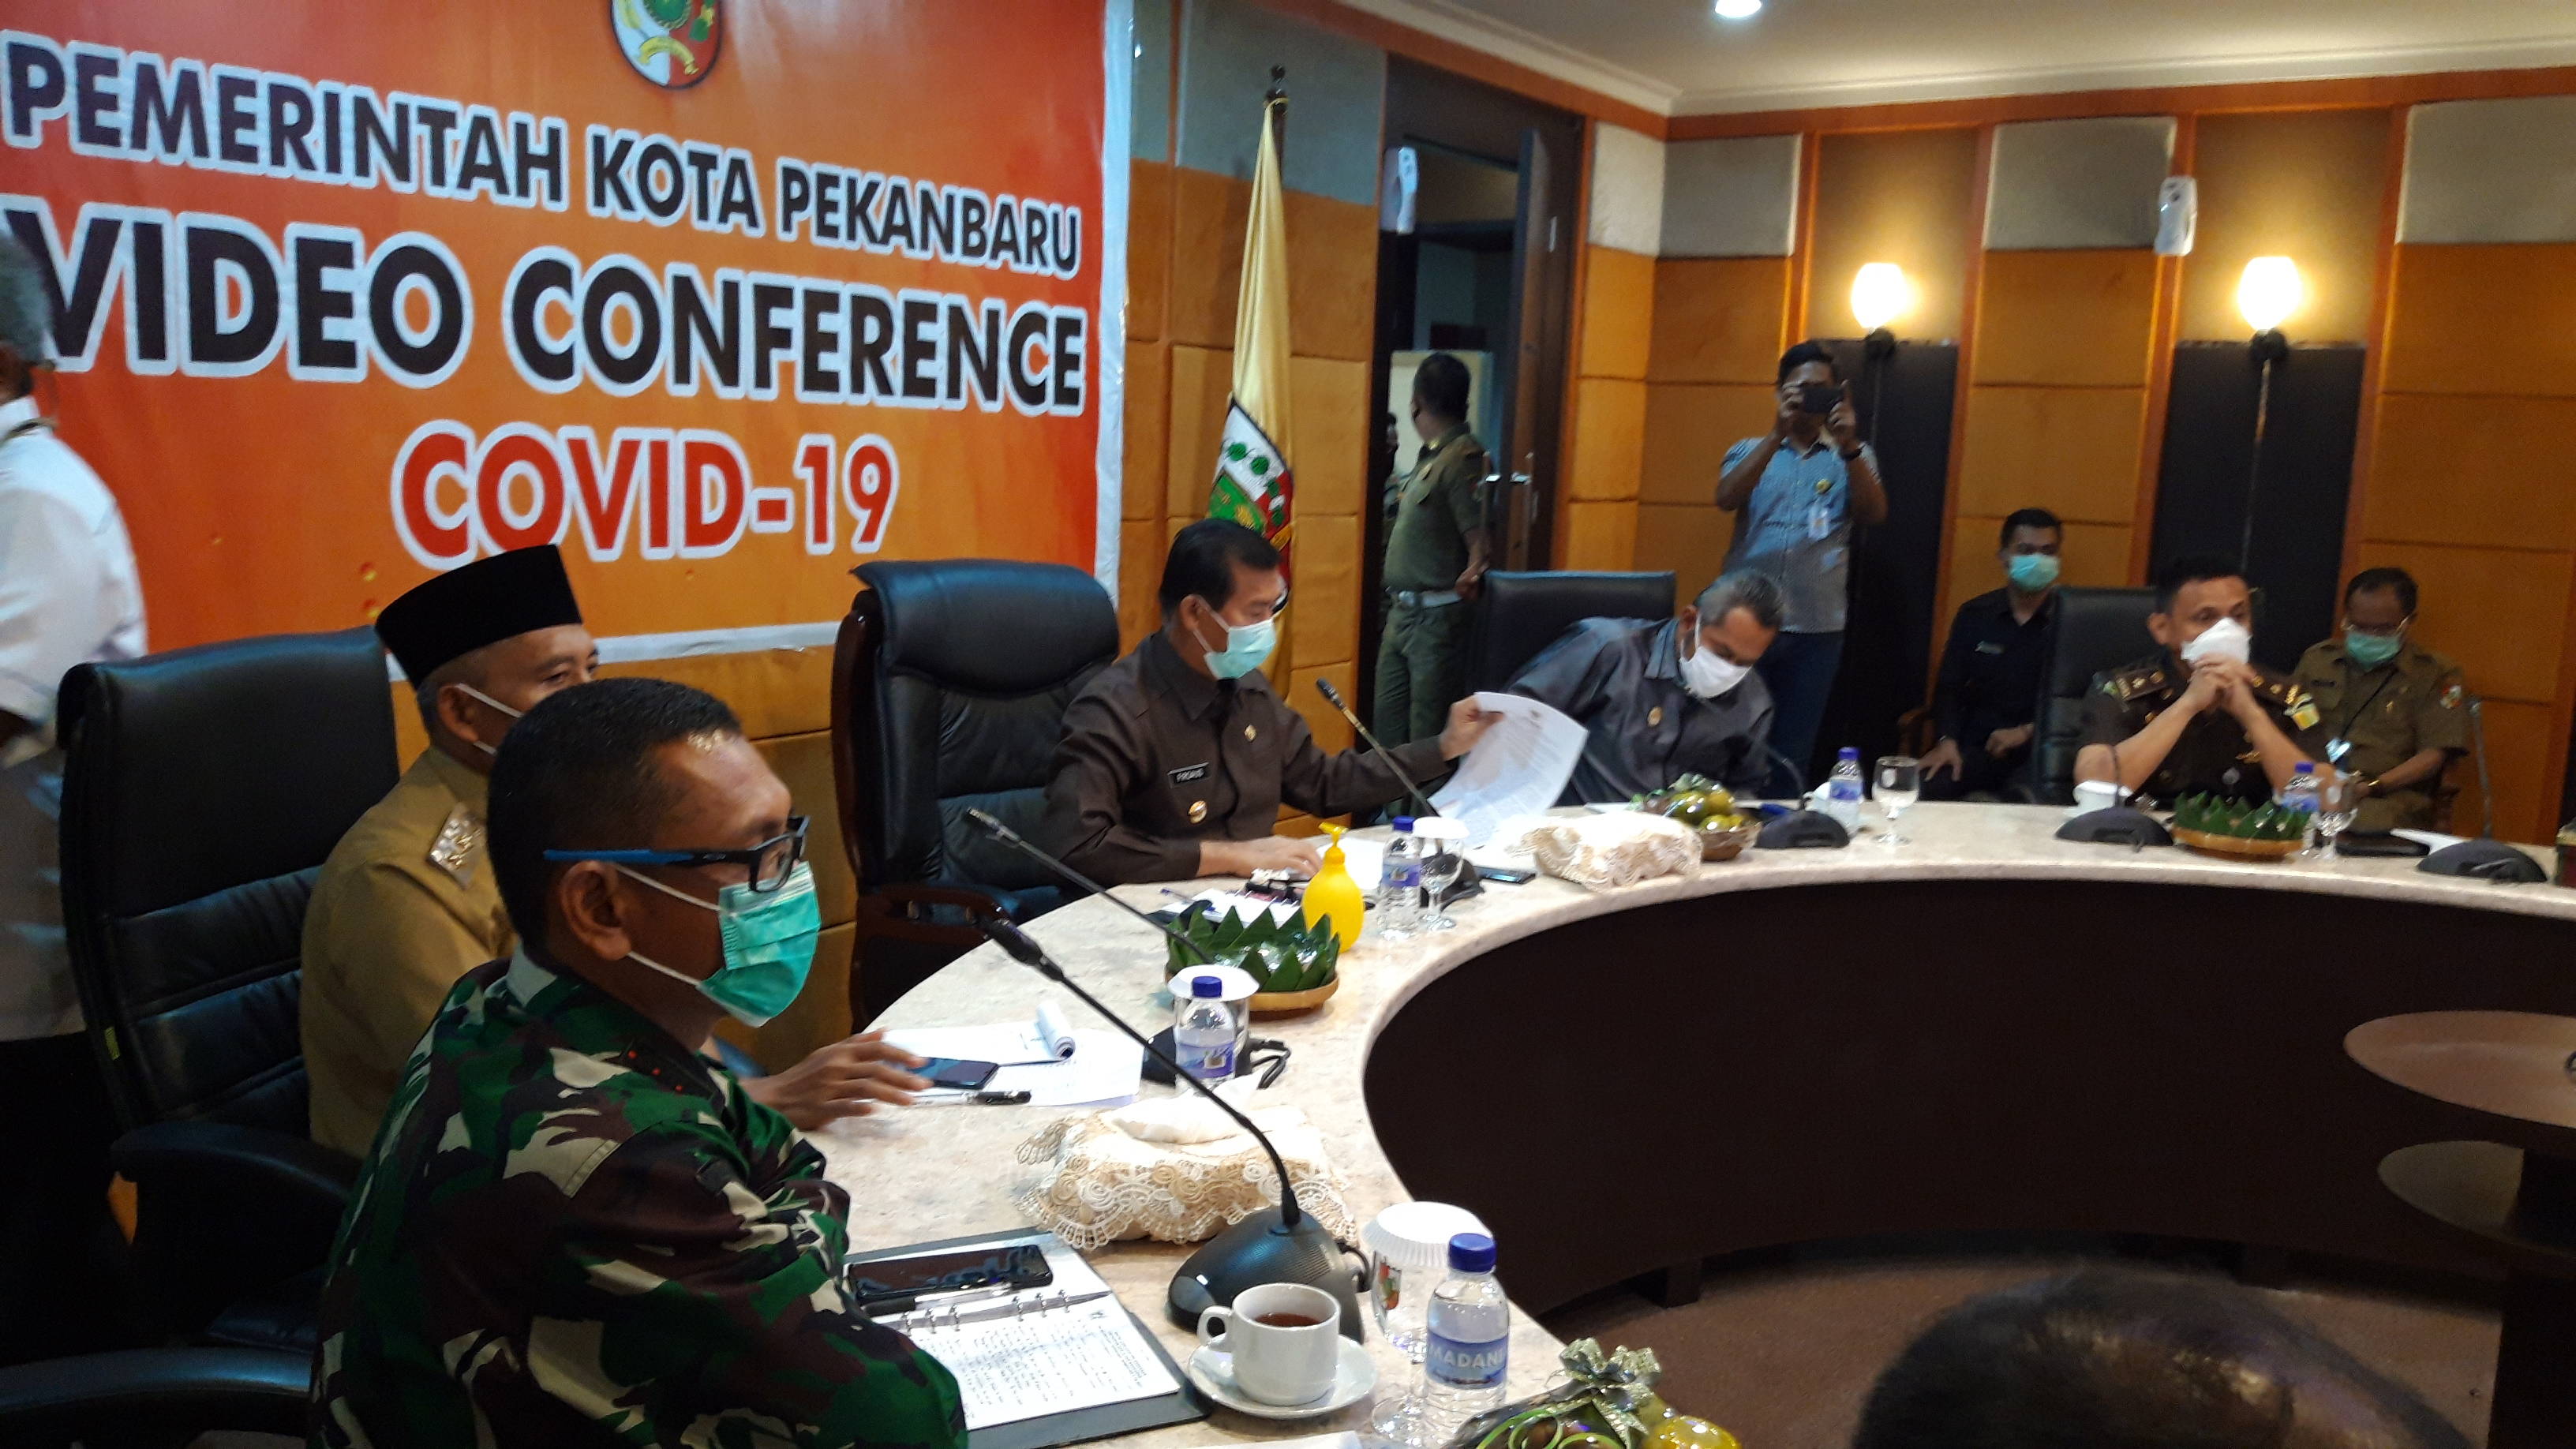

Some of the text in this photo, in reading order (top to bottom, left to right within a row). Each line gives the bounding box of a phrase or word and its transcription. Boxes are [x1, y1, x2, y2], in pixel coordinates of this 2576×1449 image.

[6, 42, 1078, 272] PEMERINTAH KOTA PEKANBARU
[2, 208, 1082, 407] VIDEO CONFERENCE
[401, 433, 893, 554] COVID-19
